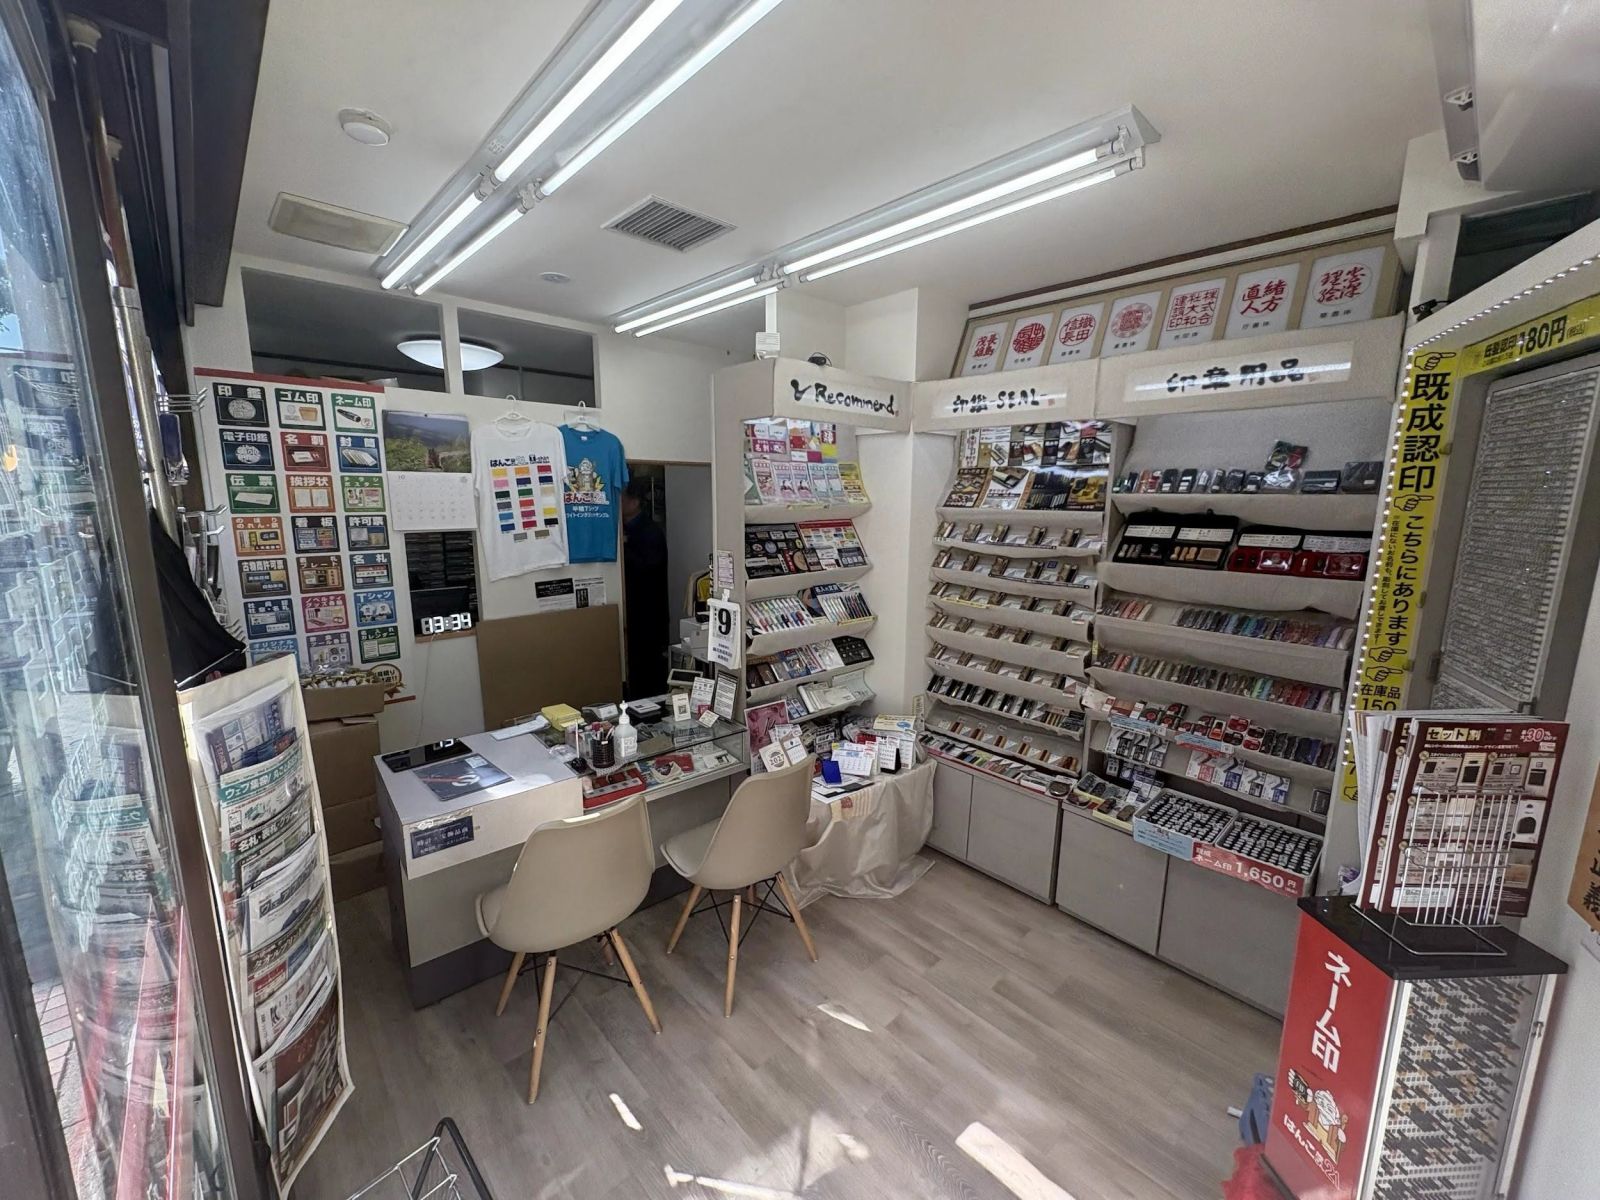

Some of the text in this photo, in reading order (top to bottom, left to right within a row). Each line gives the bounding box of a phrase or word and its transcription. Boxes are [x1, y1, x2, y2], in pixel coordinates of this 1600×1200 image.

[217, 385, 262, 399] 印鑑
[280, 390, 319, 404] ゴム印
[814, 381, 895, 416] Recommend
[335, 395, 372, 408] ネーム印
[222, 431, 269, 443] 電子印鑑
[284, 433, 324, 446] 名刺
[1398, 371, 1451, 493] 既成認印
[1384, 514, 1425, 646] こちらにあります
[356, 590, 392, 603] Tシャツ
[717, 608, 732, 636] 9
[1360, 683, 1401, 700] 在庫品
[1425, 726, 1482, 741] セット割
[1194, 854, 1233, 872] ネーム印
[1311, 950, 1352, 1074] ネーム印
